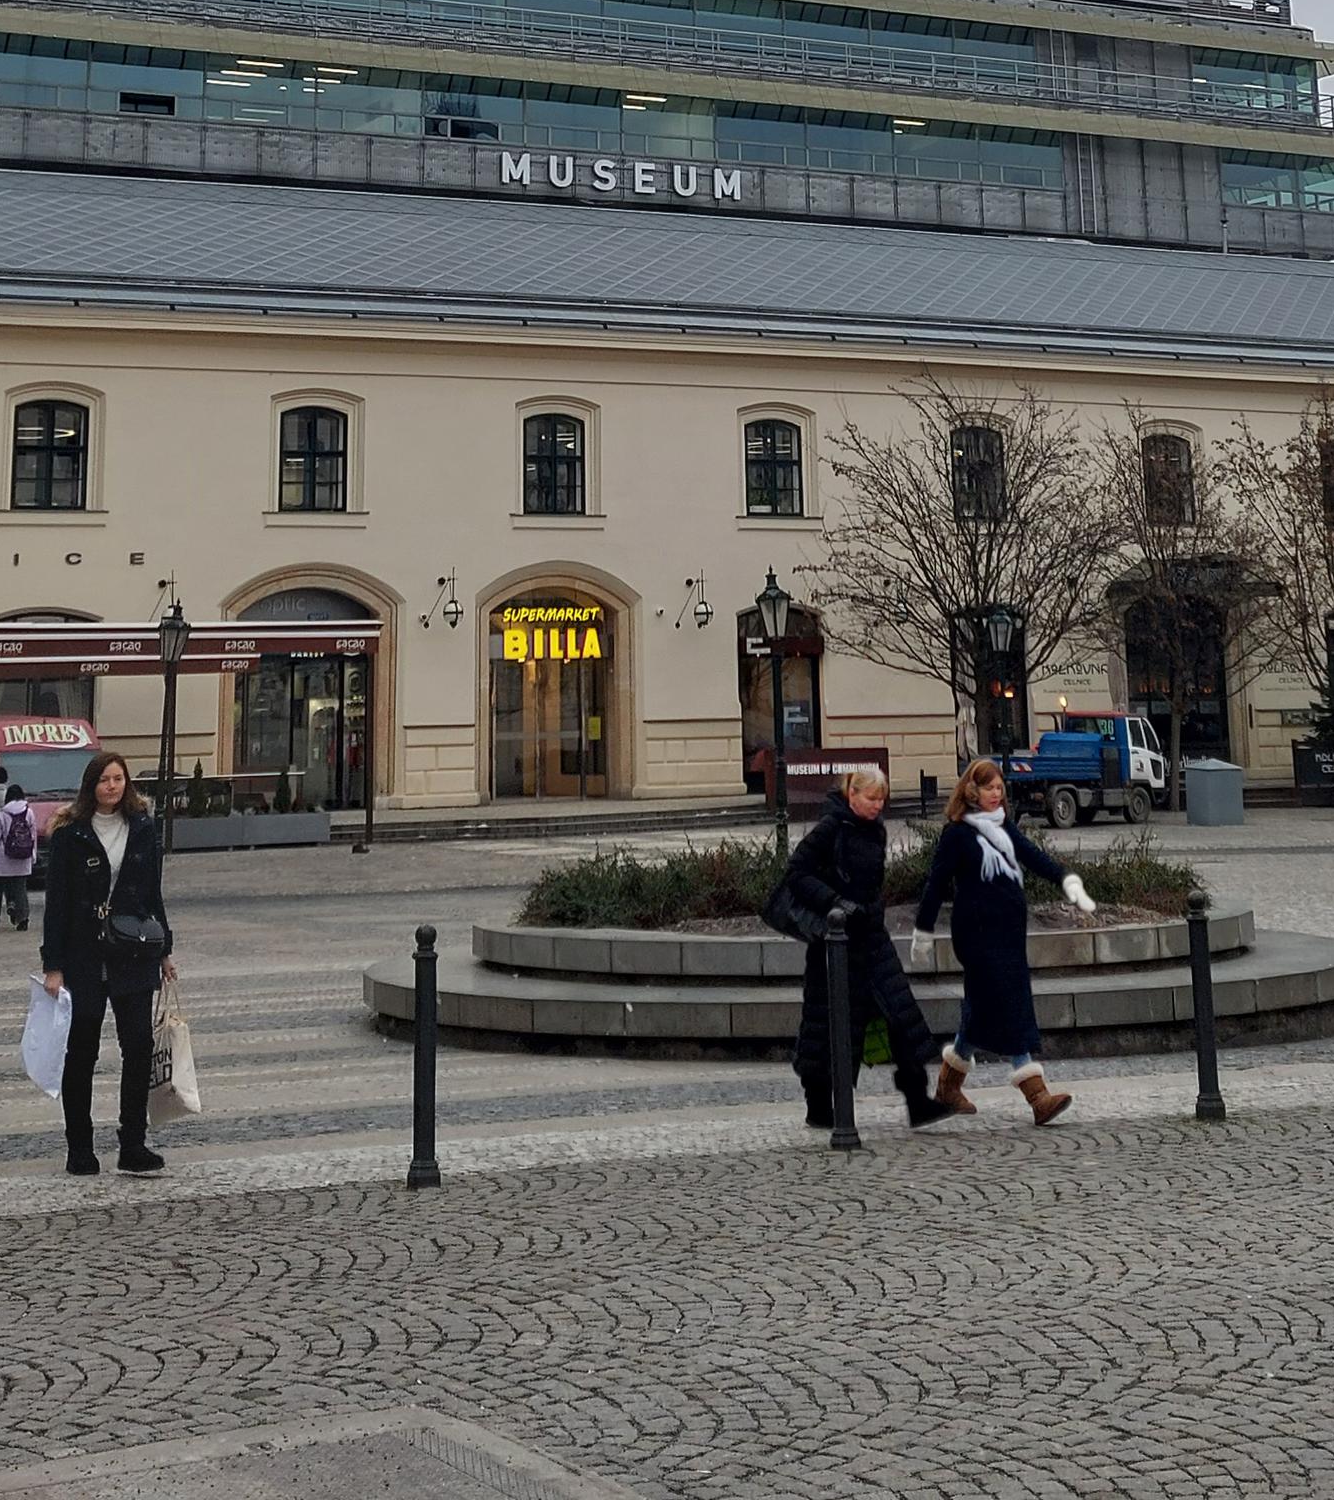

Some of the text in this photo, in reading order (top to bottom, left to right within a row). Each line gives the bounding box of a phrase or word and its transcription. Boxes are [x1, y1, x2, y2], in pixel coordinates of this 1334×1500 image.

[500, 151, 742, 201] MUSEUM
[503, 607, 600, 622] SUPERMARKET
[109, 641, 141, 652] cacao
[225, 639, 255, 650] cacao
[336, 638, 365, 649] cacao
[503, 627, 602, 660] BILLA
[80, 662, 109, 673] cacao
[221, 660, 249, 670] cacao
[787, 764, 820, 775] MUSEUM
[821, 763, 831, 775] OF
